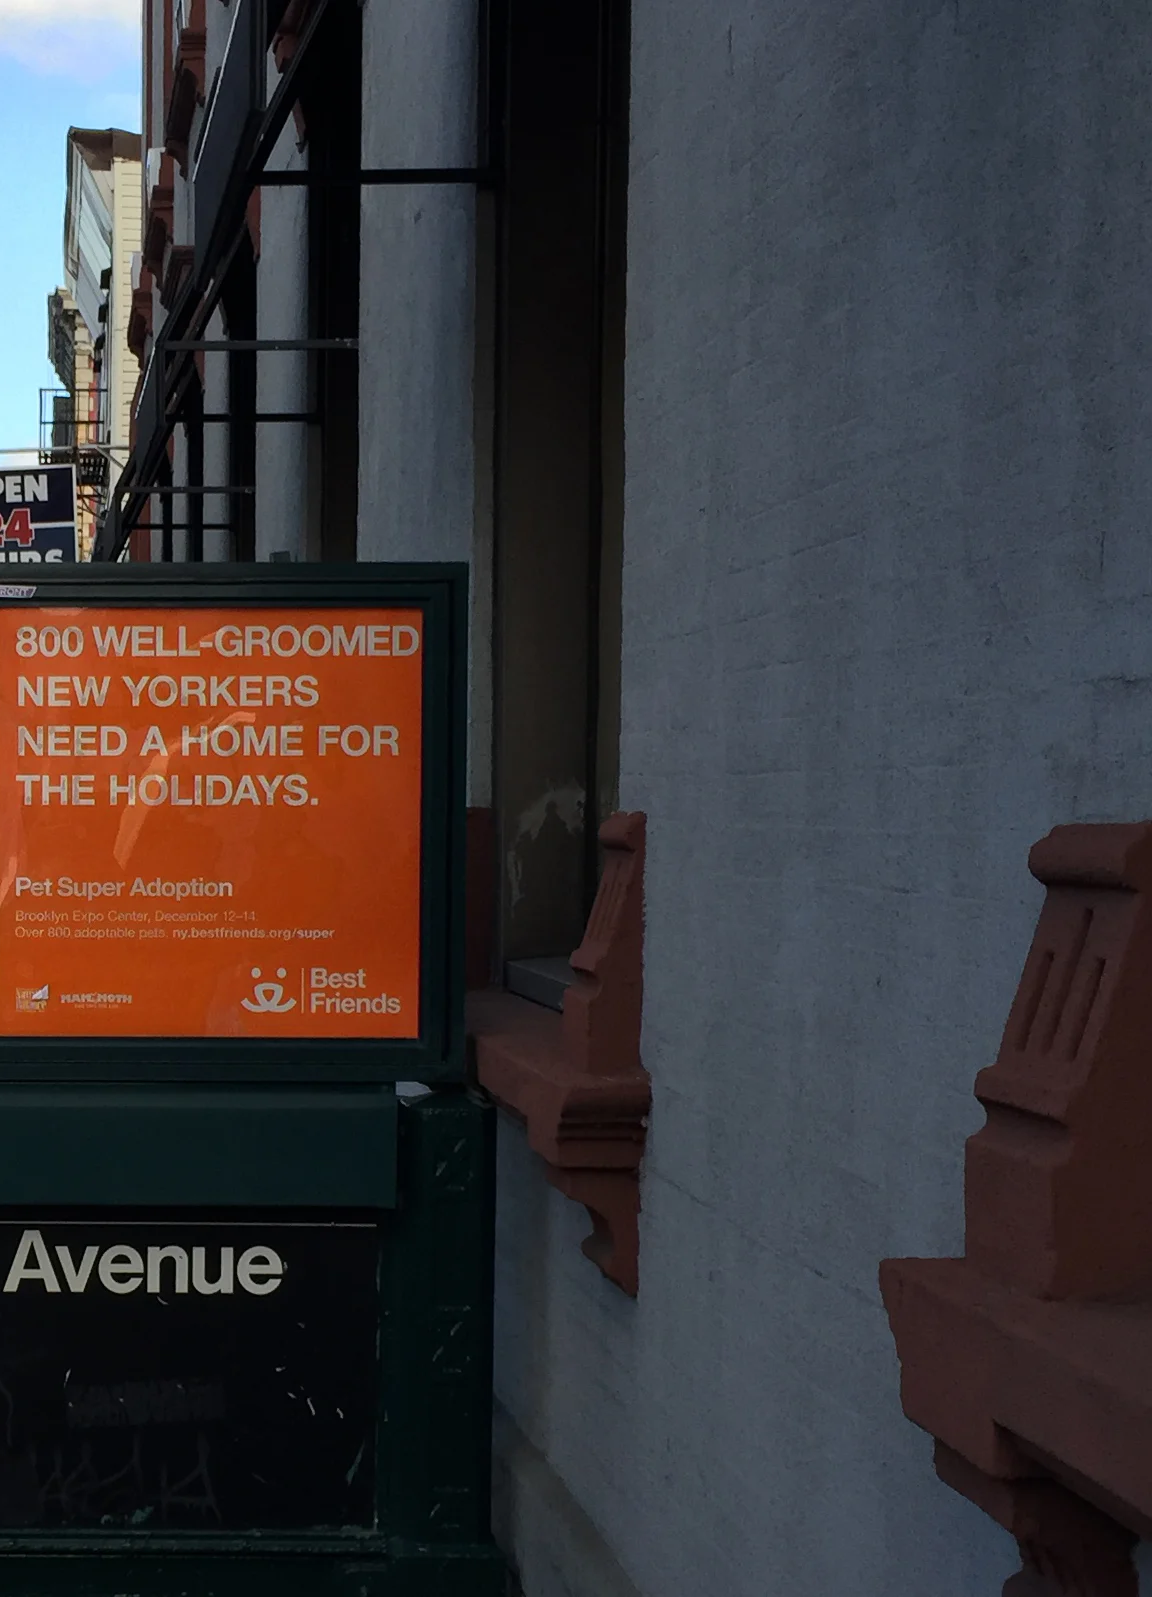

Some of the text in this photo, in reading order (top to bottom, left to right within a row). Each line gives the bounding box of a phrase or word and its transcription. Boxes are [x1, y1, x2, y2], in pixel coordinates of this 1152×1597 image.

[15, 624, 419, 658] 800 WELL-GROOMED
[17, 675, 319, 708] NEW YORKERS
[17, 724, 399, 757] NEED A HOME FOR
[16, 773, 318, 807] THE HOLIDAYS.
[15, 877, 234, 901] Pet Super Adoption
[15, 910, 69, 924] Brooklyn
[72, 911, 104, 924] Expo
[107, 911, 151, 923] Center,
[155, 911, 218, 922] December
[15, 927, 336, 940] Over 800 adoptable pets. ny.bestfriends.org/super
[310, 967, 366, 988] Best
[310, 992, 401, 1014] Friends
[2, 1228, 284, 1295] Avenue
